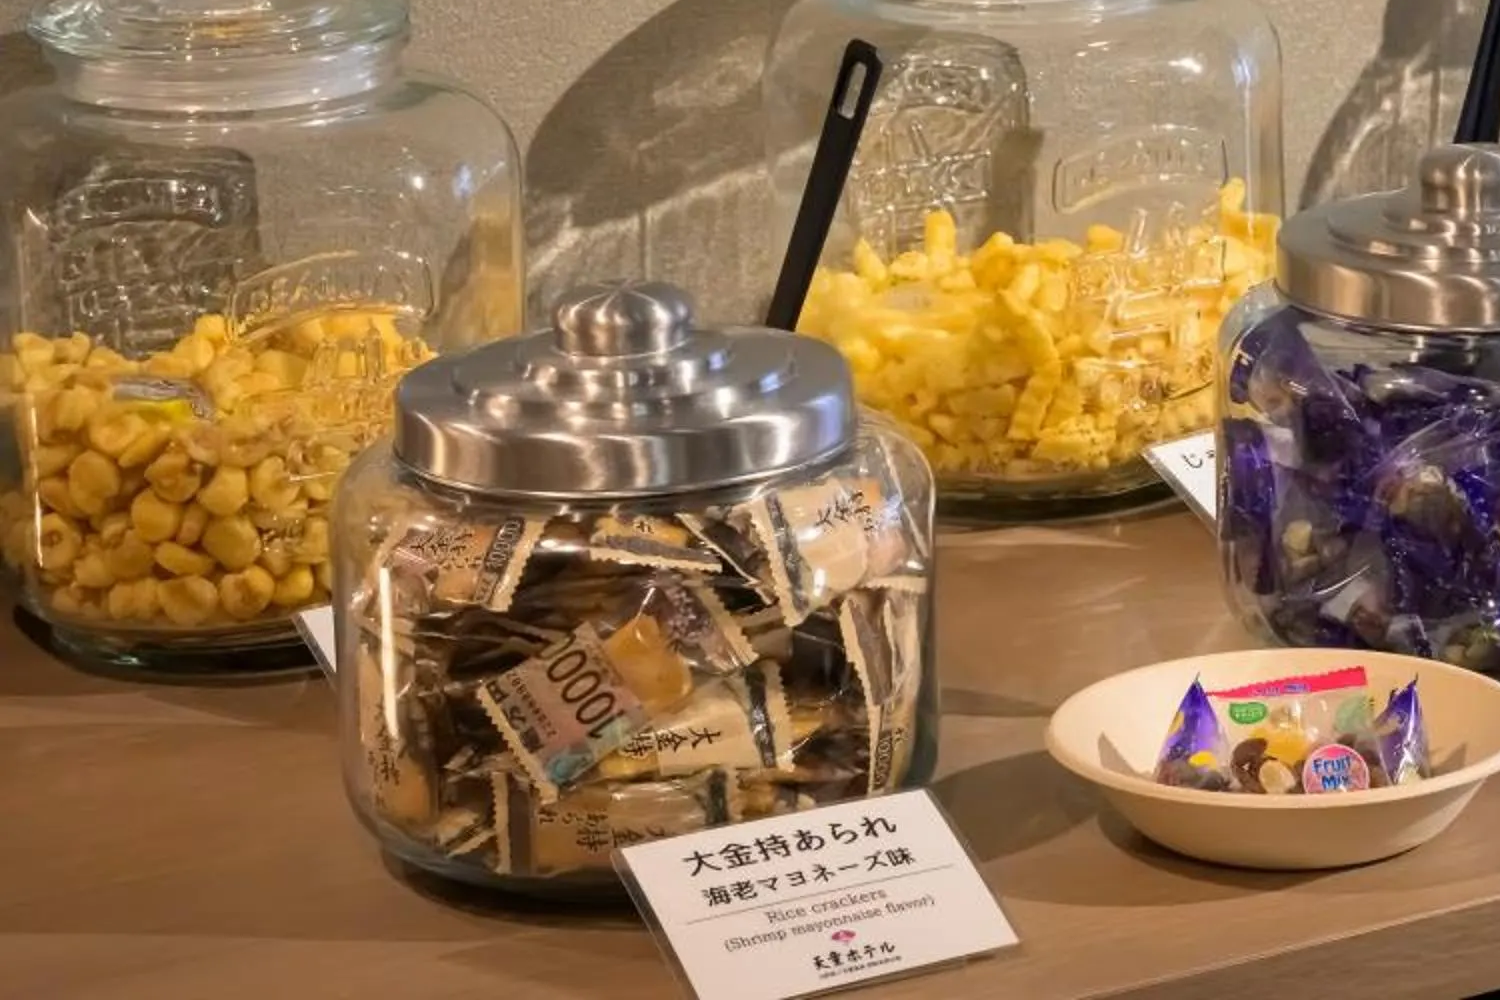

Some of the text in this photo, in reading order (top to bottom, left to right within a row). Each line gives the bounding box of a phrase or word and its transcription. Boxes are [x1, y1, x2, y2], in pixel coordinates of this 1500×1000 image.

[1311, 755, 1353, 774] Fruit
[682, 814, 897, 877] 大金持あられ
[702, 846, 917, 908] 海老マヨネーズ味
[765, 887, 888, 924] Rice crackers
[724, 894, 936, 953] (Shrimp mayonnaise flavor)
